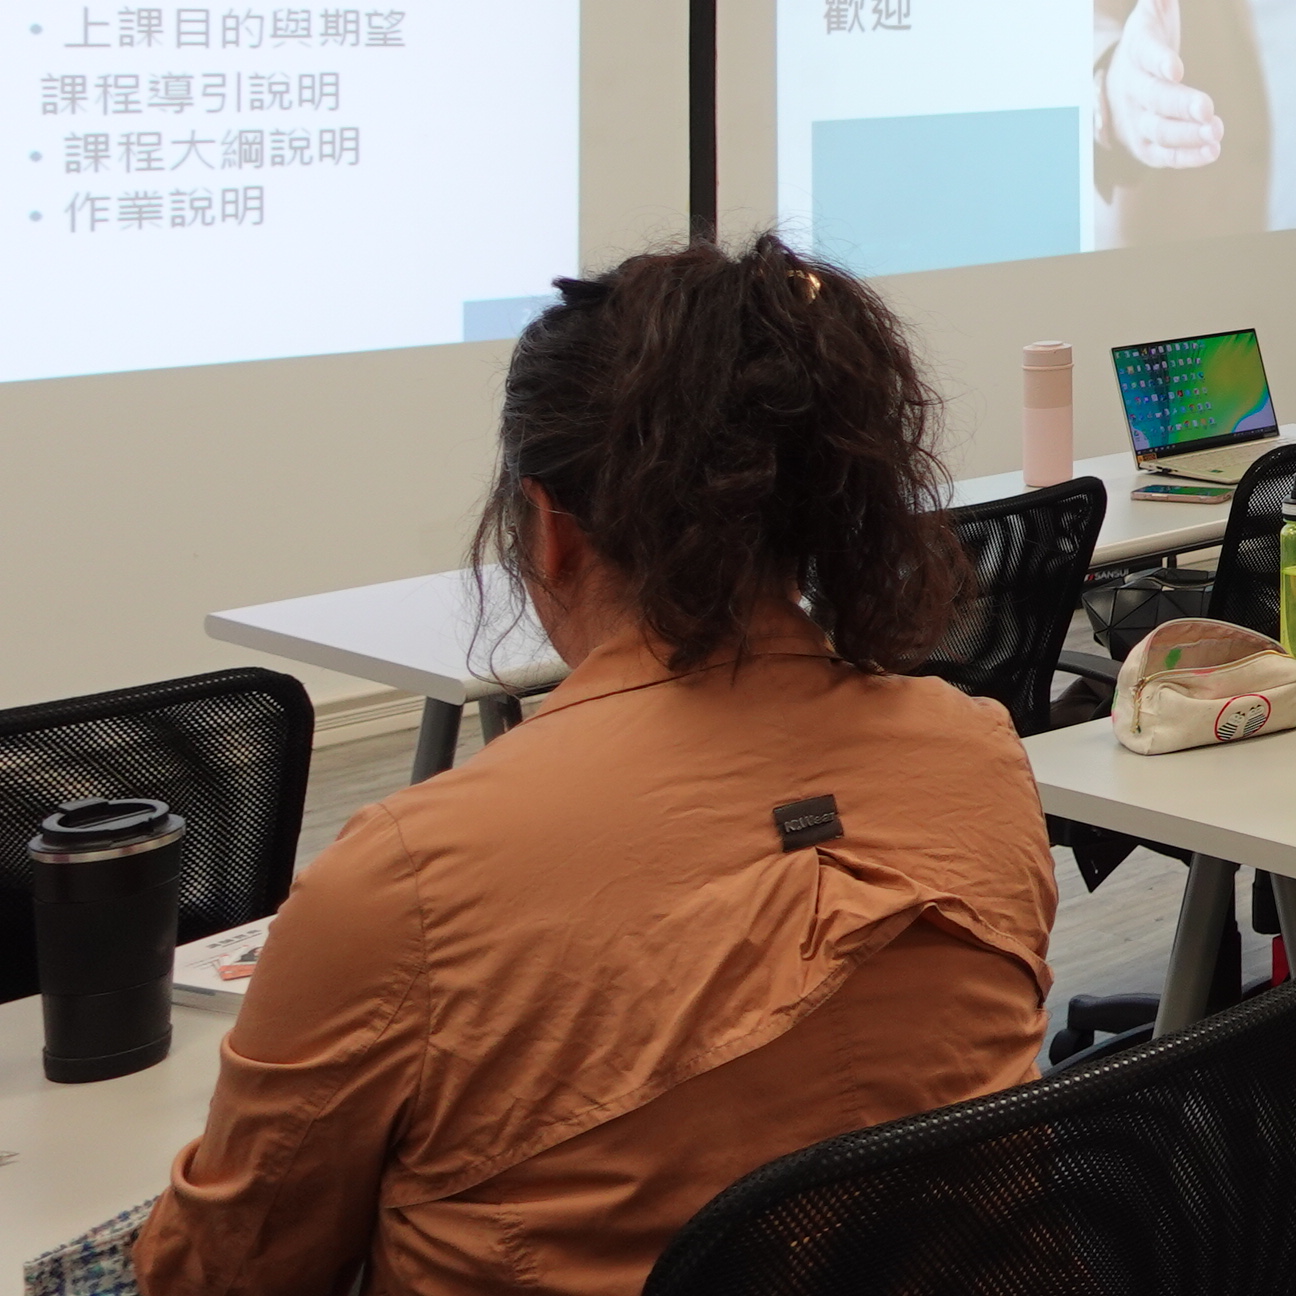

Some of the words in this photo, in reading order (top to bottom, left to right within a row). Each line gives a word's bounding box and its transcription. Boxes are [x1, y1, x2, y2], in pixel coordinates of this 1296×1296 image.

[63, 6, 407, 50] 上課目的與期望
[40, 71, 340, 117] 課程導引說明
[63, 127, 360, 175] 課程大綱說明
[63, 186, 265, 233] 作業說明
[1094, 568, 1130, 581] SANSUI
